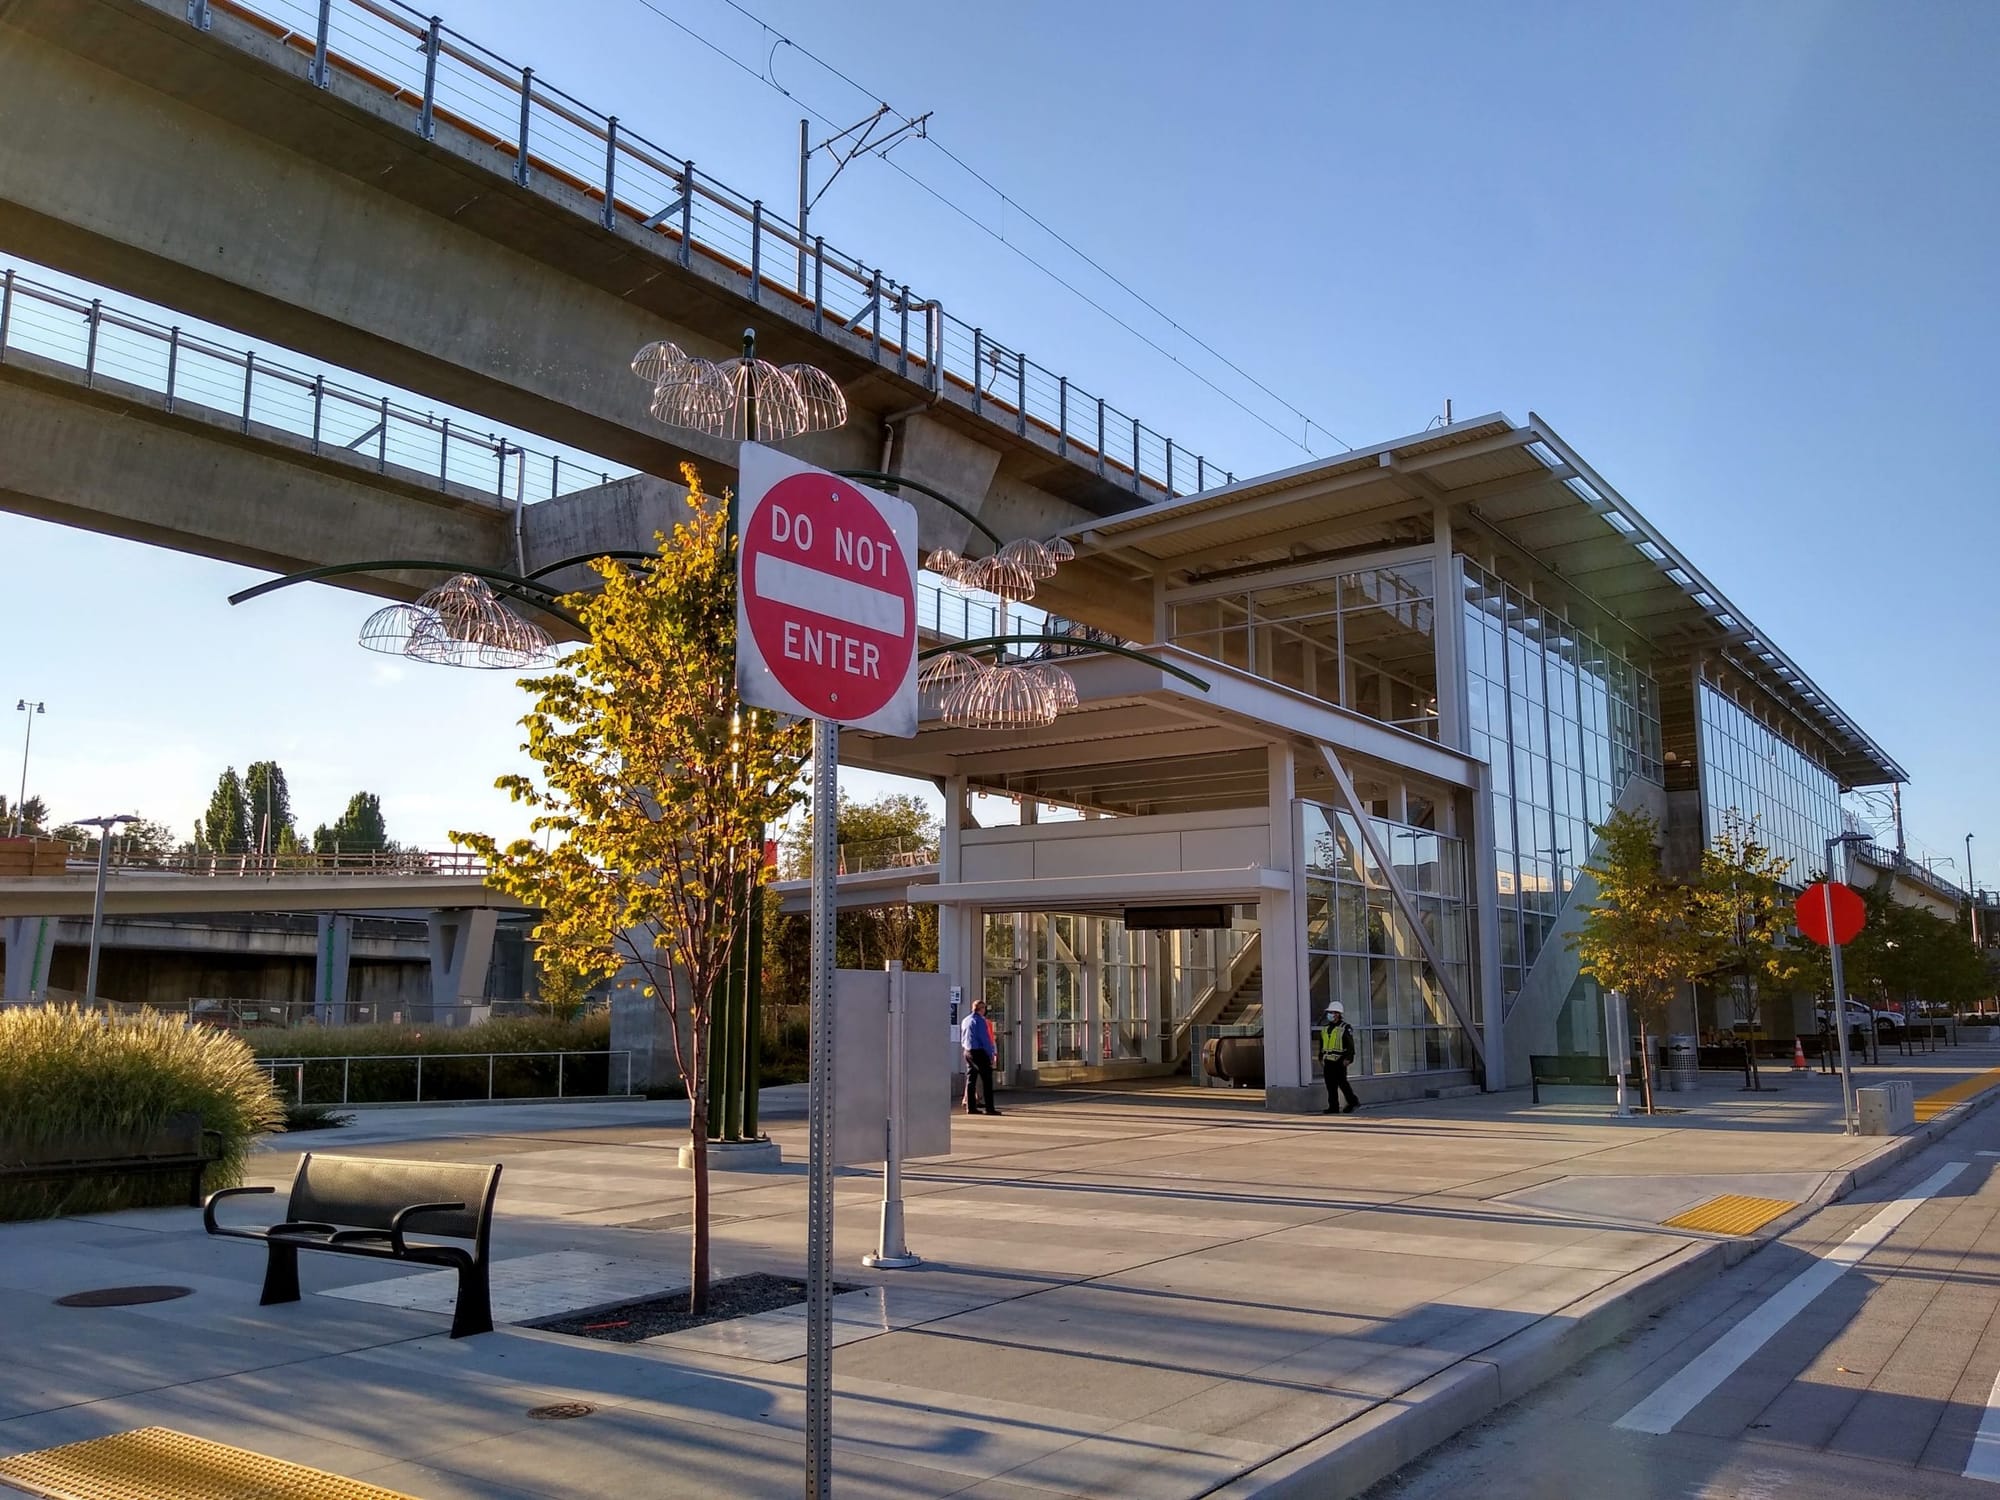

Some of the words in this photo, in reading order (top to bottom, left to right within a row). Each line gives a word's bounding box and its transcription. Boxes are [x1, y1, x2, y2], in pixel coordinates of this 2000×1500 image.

[772, 504, 813, 551] DO
[835, 527, 892, 577] NOT
[784, 620, 880, 680] ENTER
